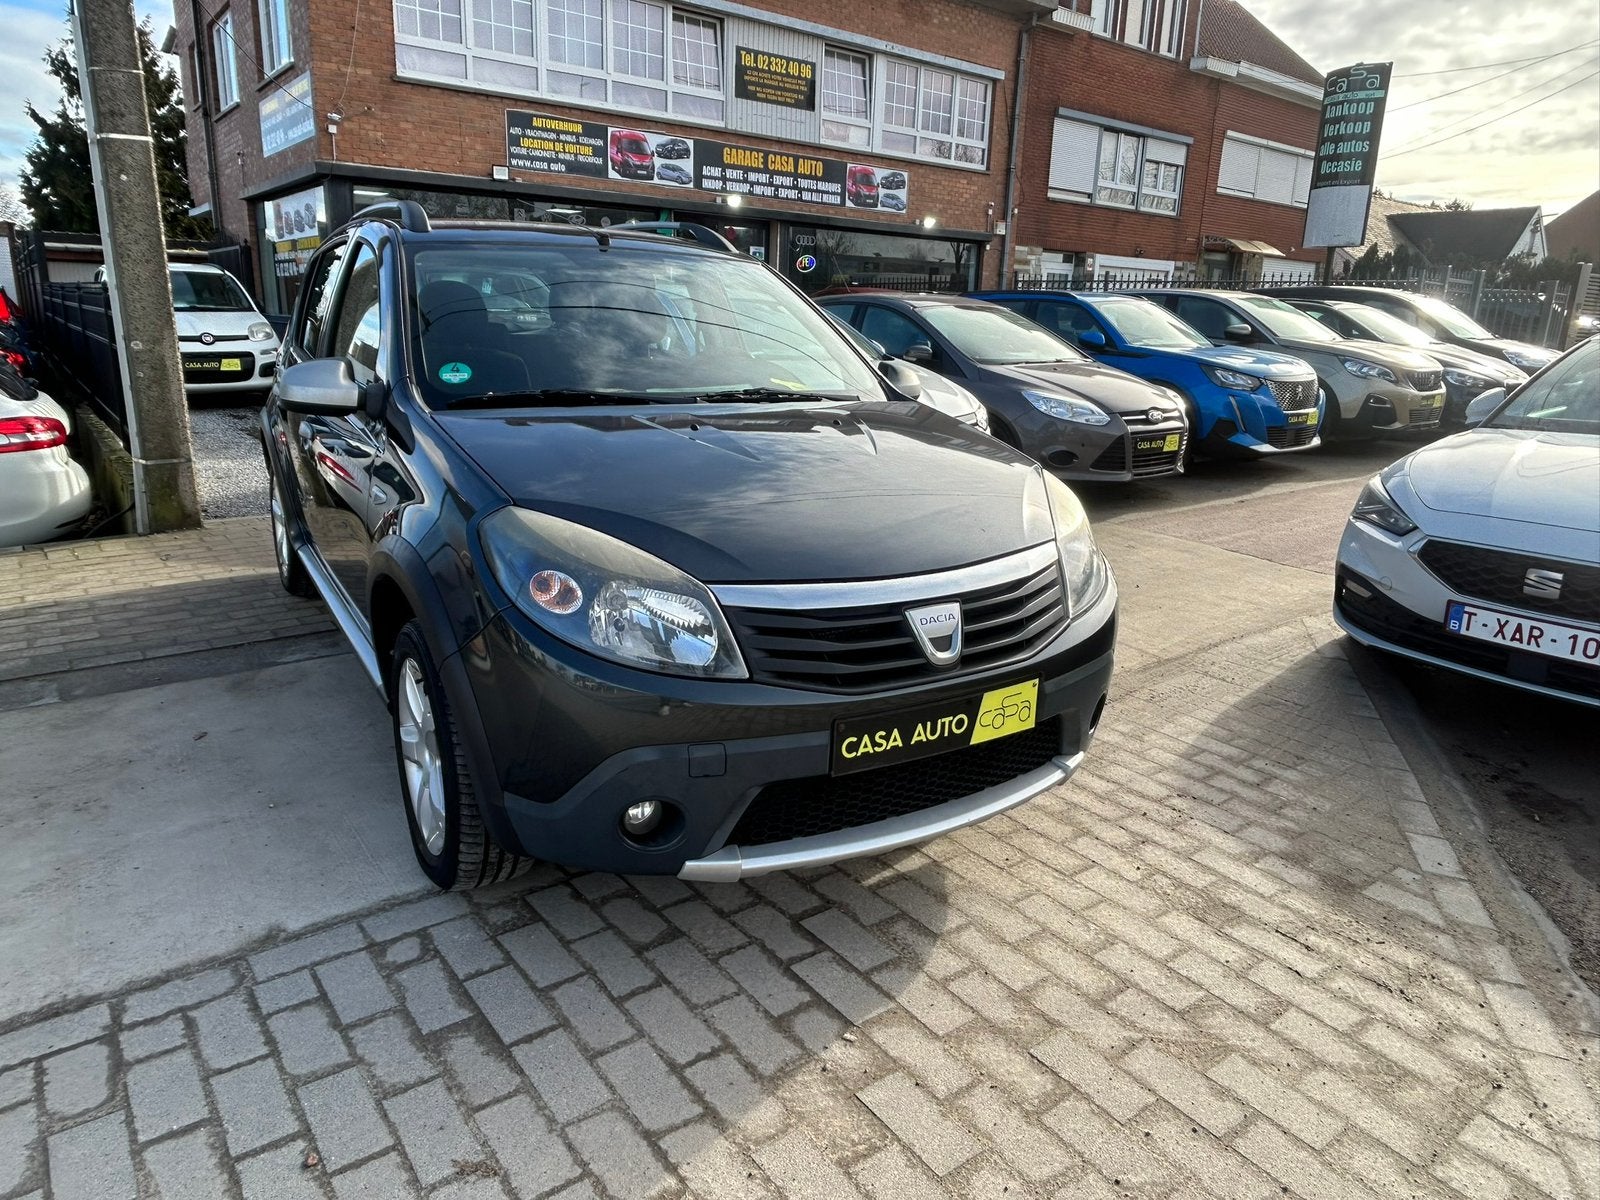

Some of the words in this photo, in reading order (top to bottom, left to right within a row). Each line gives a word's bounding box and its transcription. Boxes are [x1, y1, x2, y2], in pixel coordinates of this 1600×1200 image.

[740, 50, 756, 68] Tel.
[758, 54, 768, 70] 02
[770, 57, 786, 74] 332
[788, 61, 798, 76] 40
[800, 64, 812, 78] 96
[1326, 102, 1374, 118] Aankoop
[510, 126, 522, 134] AUTO
[532, 116, 582, 133] AUTOVERHUUR
[1324, 121, 1370, 137] Verkoop
[520, 137, 554, 150] LOCATION
[554, 142, 564, 152] DE
[564, 143, 593, 156] VOITURE
[1320, 142, 1335, 156] alle
[1337, 140, 1370, 154] autos
[550, 162, 566, 172] auto
[723, 147, 764, 168] GARAGE
[768, 154, 794, 172] CASA
[798, 158, 823, 177] AUTO
[1321, 158, 1362, 174] Occasie
[702, 166, 721, 177] ACHAT
[726, 168, 744, 180] VENTE
[748, 172, 770, 182] IMPORT
[773, 175, 794, 186] EXPORT
[798, 178, 816, 190] TOUTES
[702, 178, 722, 190] INKOOP
[726, 182, 750, 193] VERKOOP
[753, 184, 775, 196] IMPORT
[778, 188, 798, 200] EXPORT
[1137, 440, 1150, 449] CASA
[1150, 440, 1164, 448] AUTO
[920, 613, 956, 626] DACIA
[1450, 620, 1460, 630] B
[841, 728, 903, 758] CASA
[910, 713, 969, 745] AUTO
